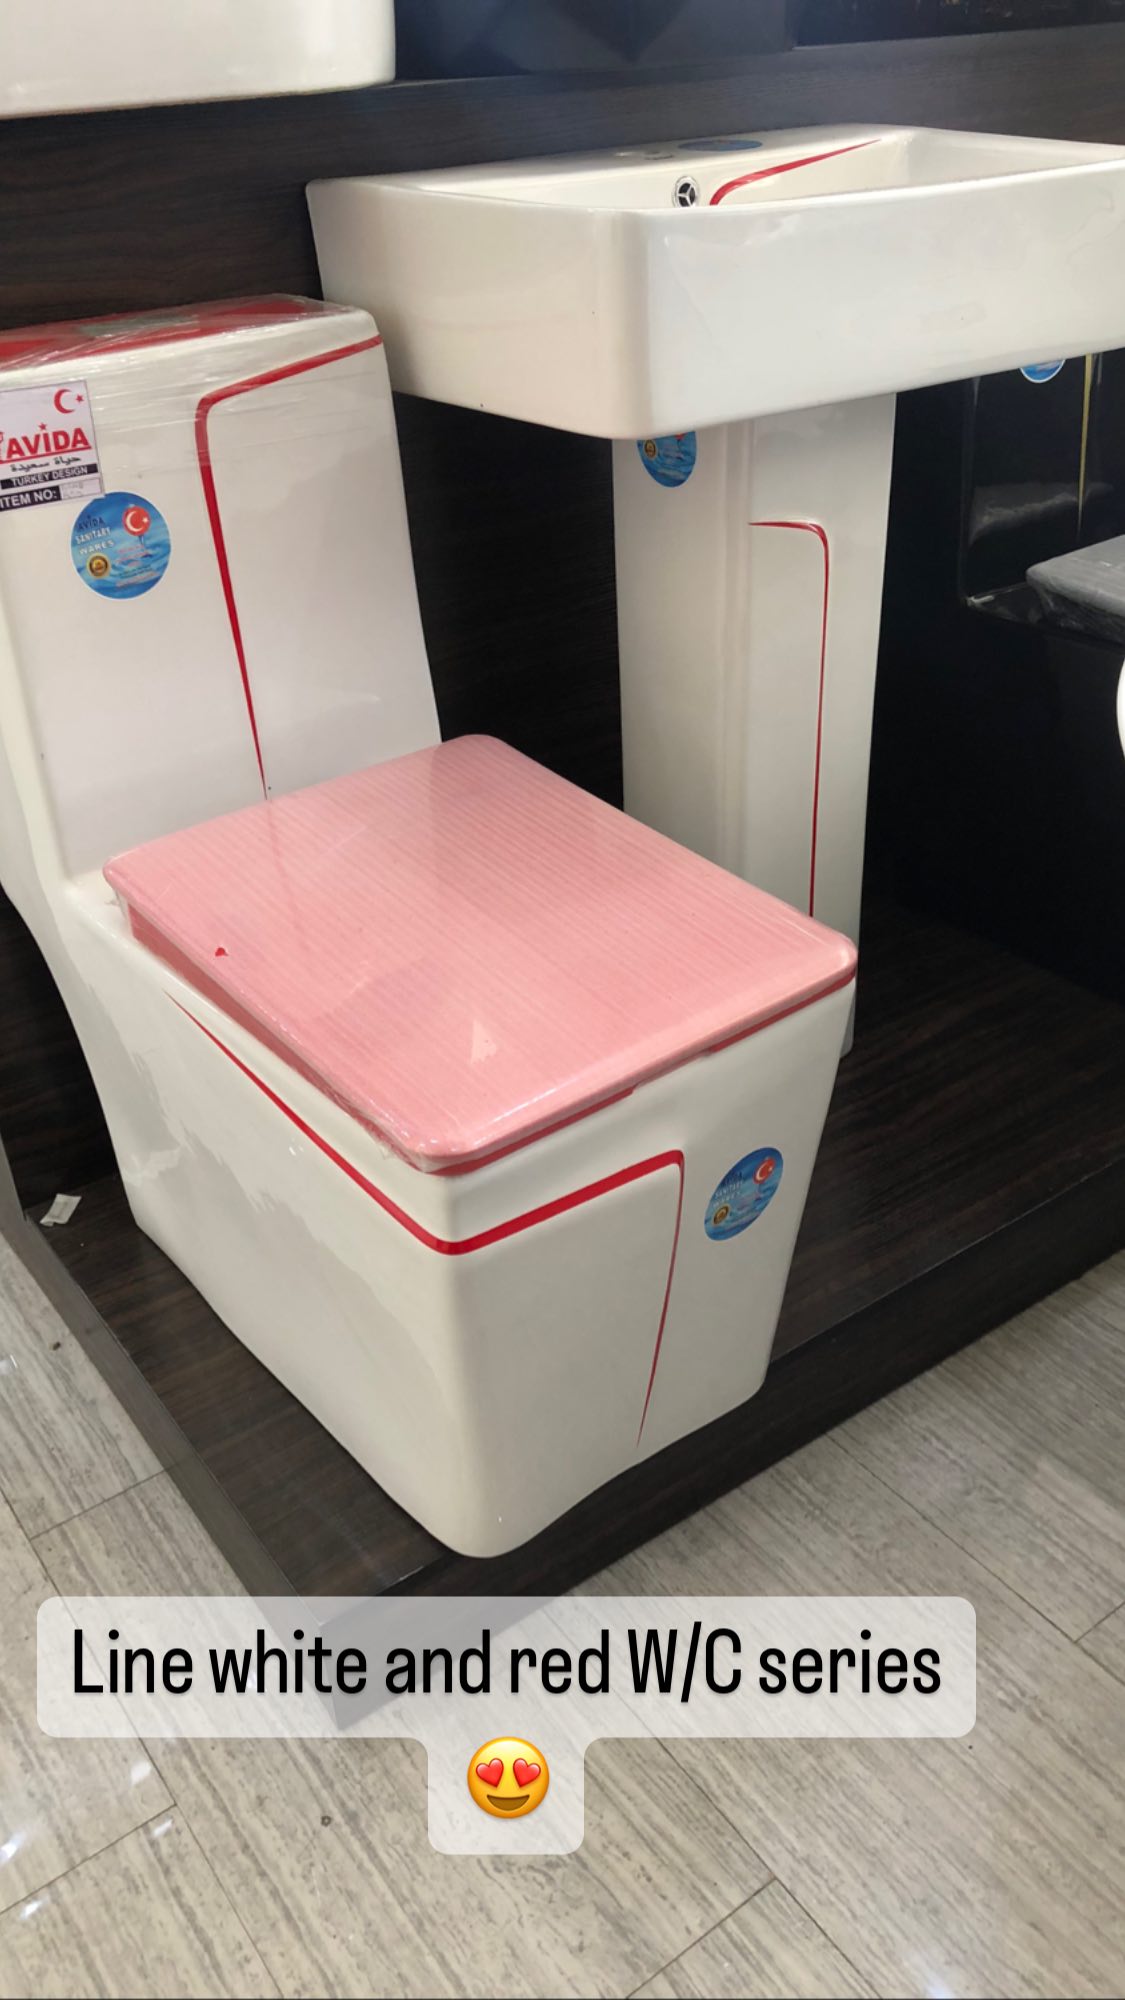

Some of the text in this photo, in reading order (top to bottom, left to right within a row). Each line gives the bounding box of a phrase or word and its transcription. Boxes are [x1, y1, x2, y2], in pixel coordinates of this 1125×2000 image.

[12, 466, 88, 487] TURKEY DESIGN
[0, 494, 31, 508] ITEM
[33, 488, 57, 502] NO:
